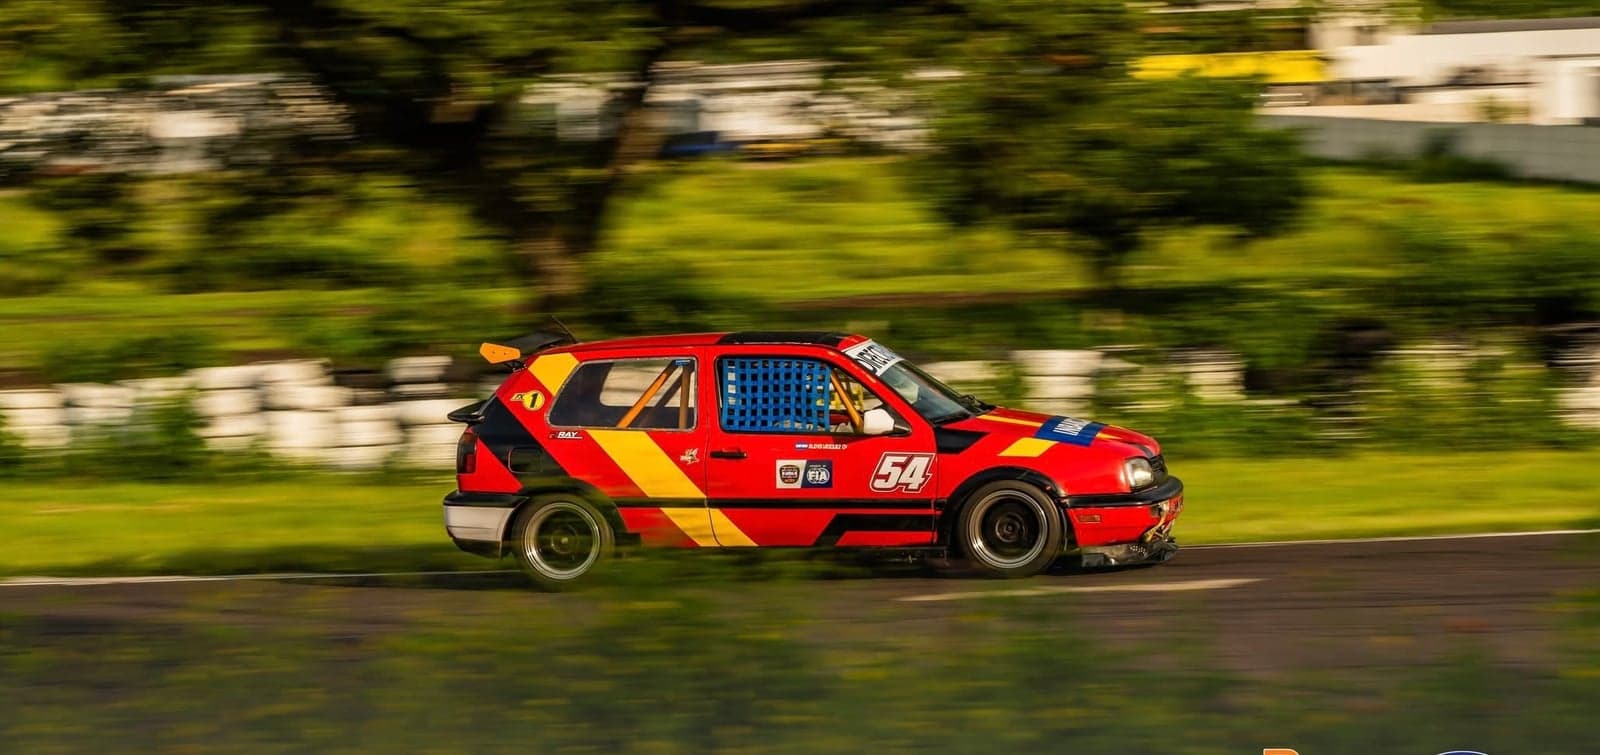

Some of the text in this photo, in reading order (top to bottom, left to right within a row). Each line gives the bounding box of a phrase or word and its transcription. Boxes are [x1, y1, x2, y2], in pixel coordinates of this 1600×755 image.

[529, 393, 539, 408] 1
[808, 470, 827, 481] FIA
[873, 456, 930, 489] 54
